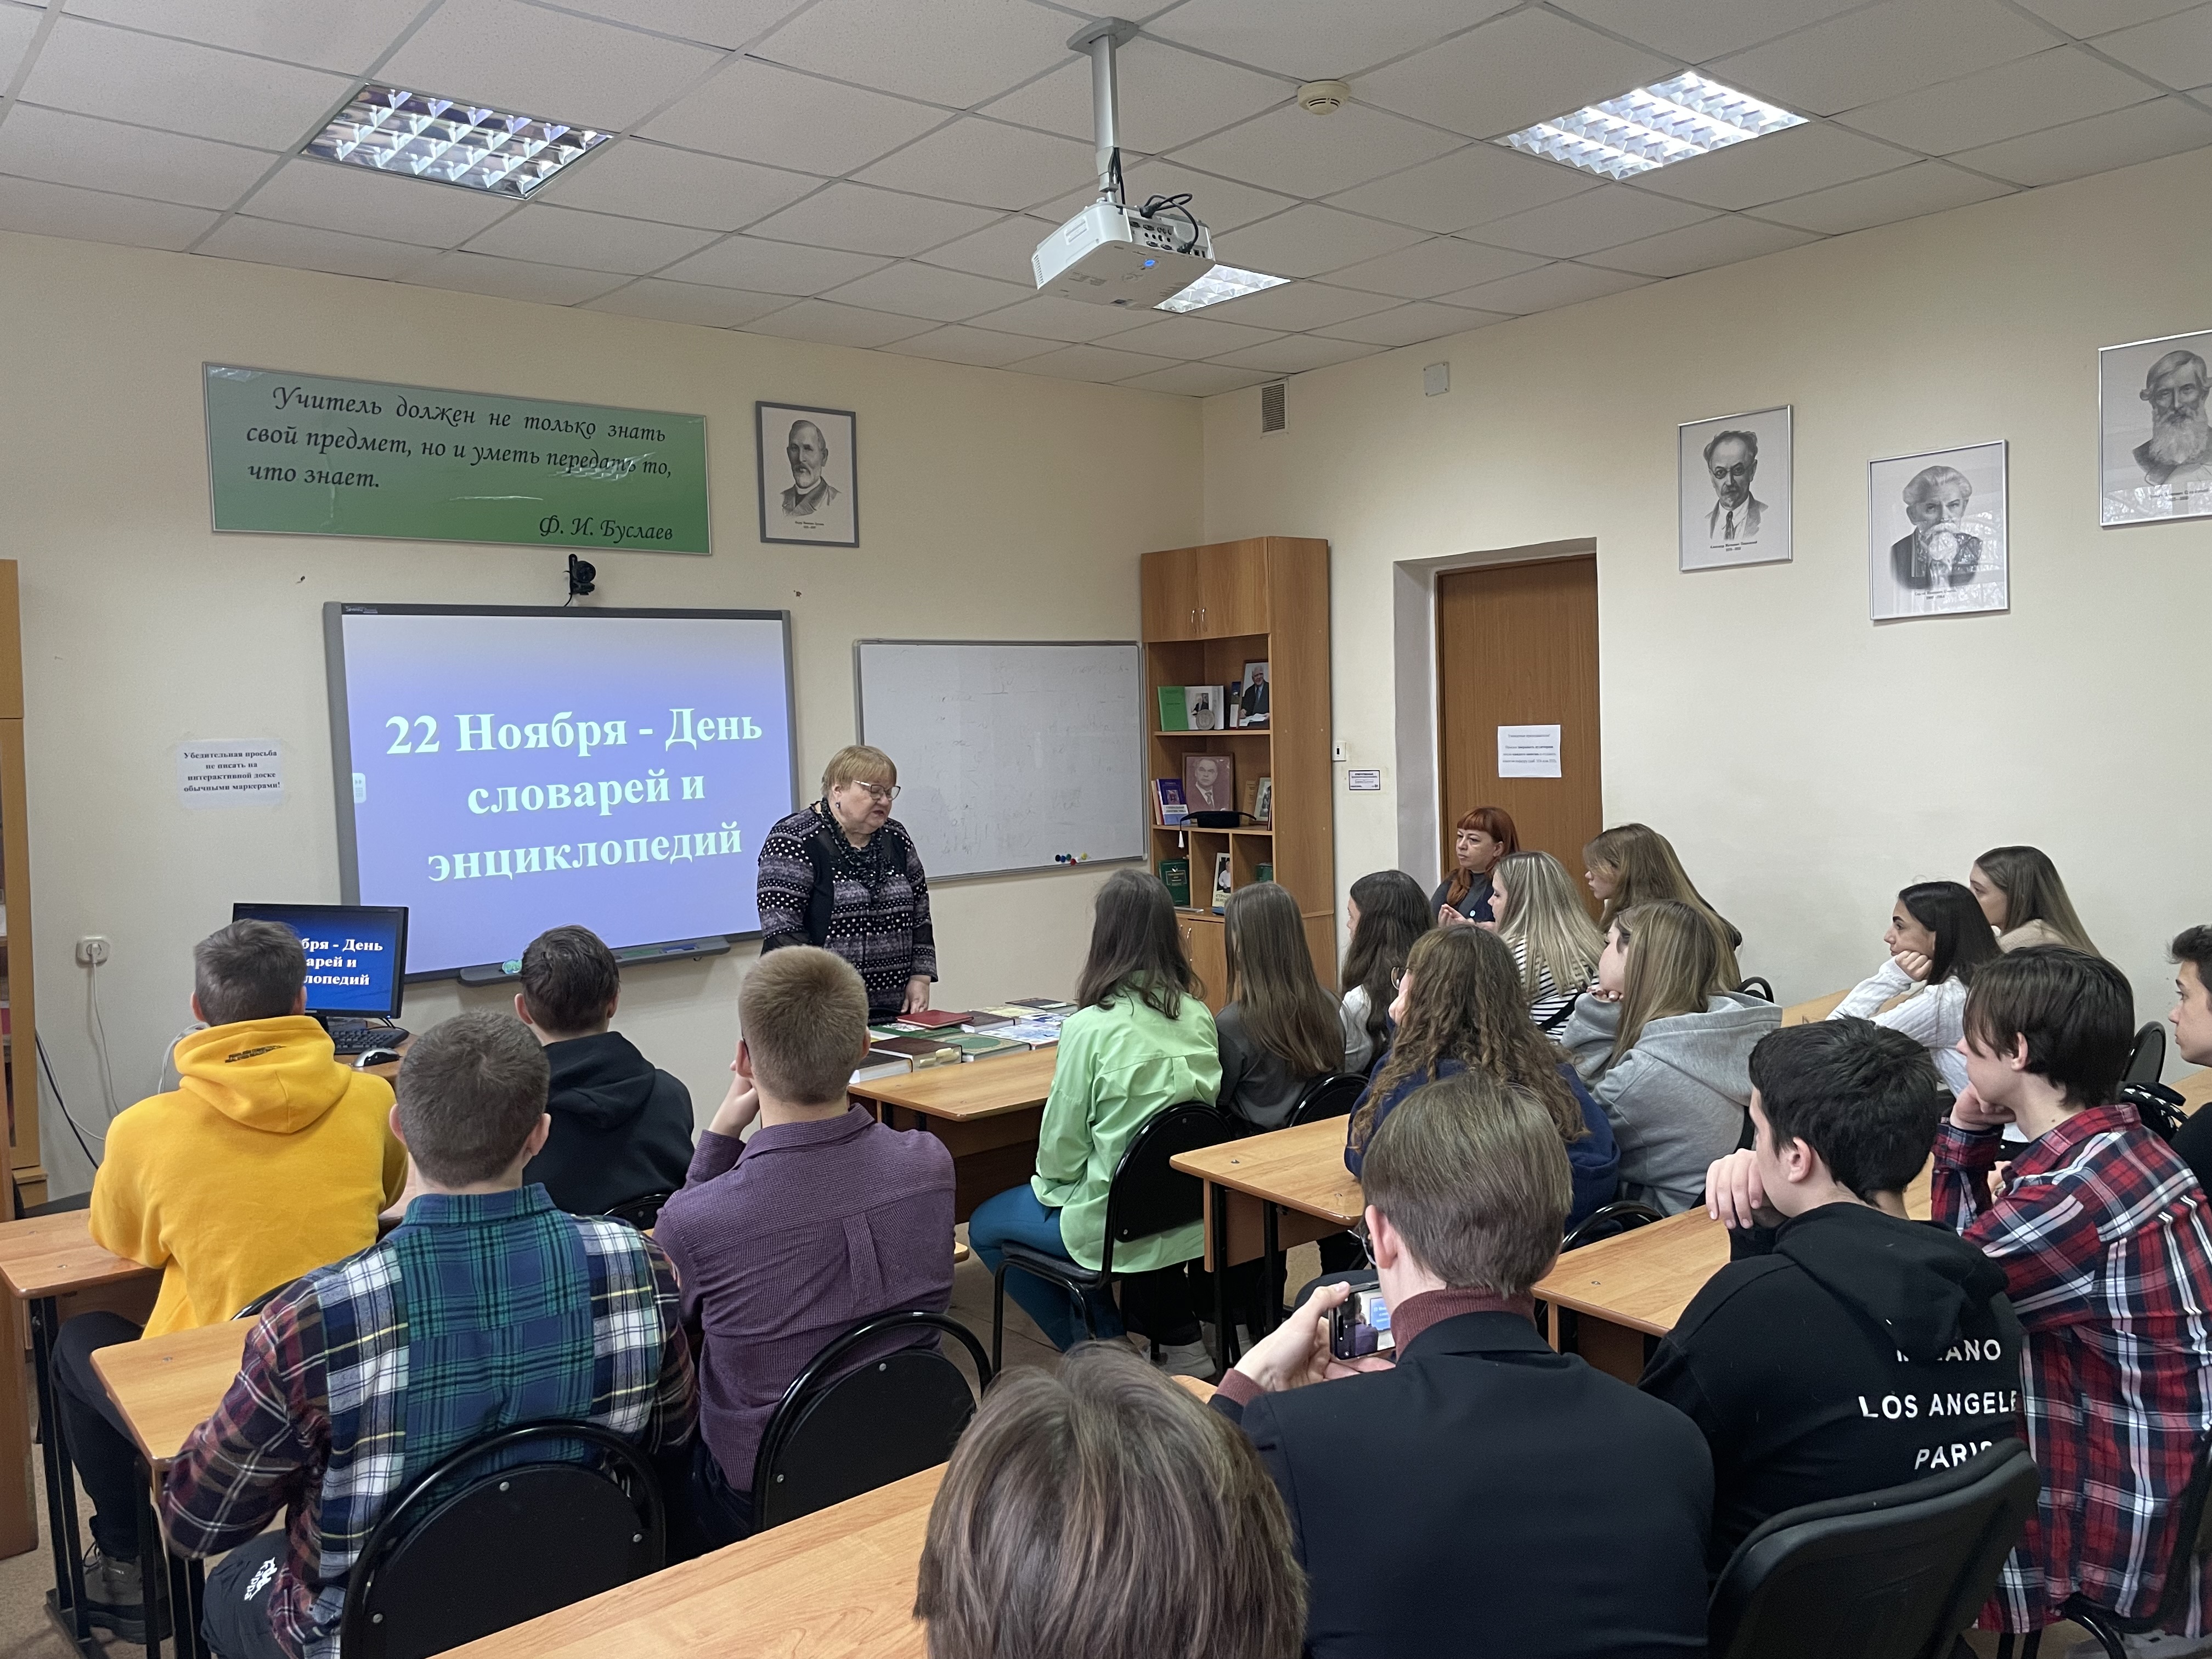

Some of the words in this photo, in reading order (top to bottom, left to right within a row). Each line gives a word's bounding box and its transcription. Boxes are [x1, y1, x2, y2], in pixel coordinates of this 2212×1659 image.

[273, 387, 382, 415] Учитель
[396, 394, 476, 427] должен
[489, 413, 511, 426] не
[524, 416, 596, 439] только
[607, 425, 665, 442] знать
[247, 426, 298, 444] свой
[307, 427, 411, 458] предмет,
[421, 442, 445, 456] но
[453, 444, 466, 458] и
[470, 445, 540, 466] уметь
[546, 449, 636, 473] передать
[642, 460, 671, 478] то,
[248, 465, 296, 482] что
[304, 469, 379, 488] знает.
[539, 515, 563, 537] Ф.
[571, 517, 594, 536] И.
[601, 520, 673, 544] Буслаев
[386, 715, 440, 754] 22
[455, 711, 628, 757] Ноября
[639, 729, 653, 737] -
[665, 708, 762, 751] День
[245, 750, 277, 758] просьба
[188, 772, 252, 781] интерактивной
[232, 782, 280, 791] маркерами!
[468, 769, 669, 816] словарей
[681, 775, 705, 801] и
[428, 821, 742, 882] энциклопедий
[302, 938, 329, 952] бря
[342, 939, 383, 952] День
[306, 956, 343, 969] арей
[347, 959, 357, 968] и
[303, 974, 370, 986] лопедий
[1897, 1339, 2001, 1362] ANO
[1858, 1395, 1918, 1419] LOS
[1928, 1390, 2017, 1416] ANGELE
